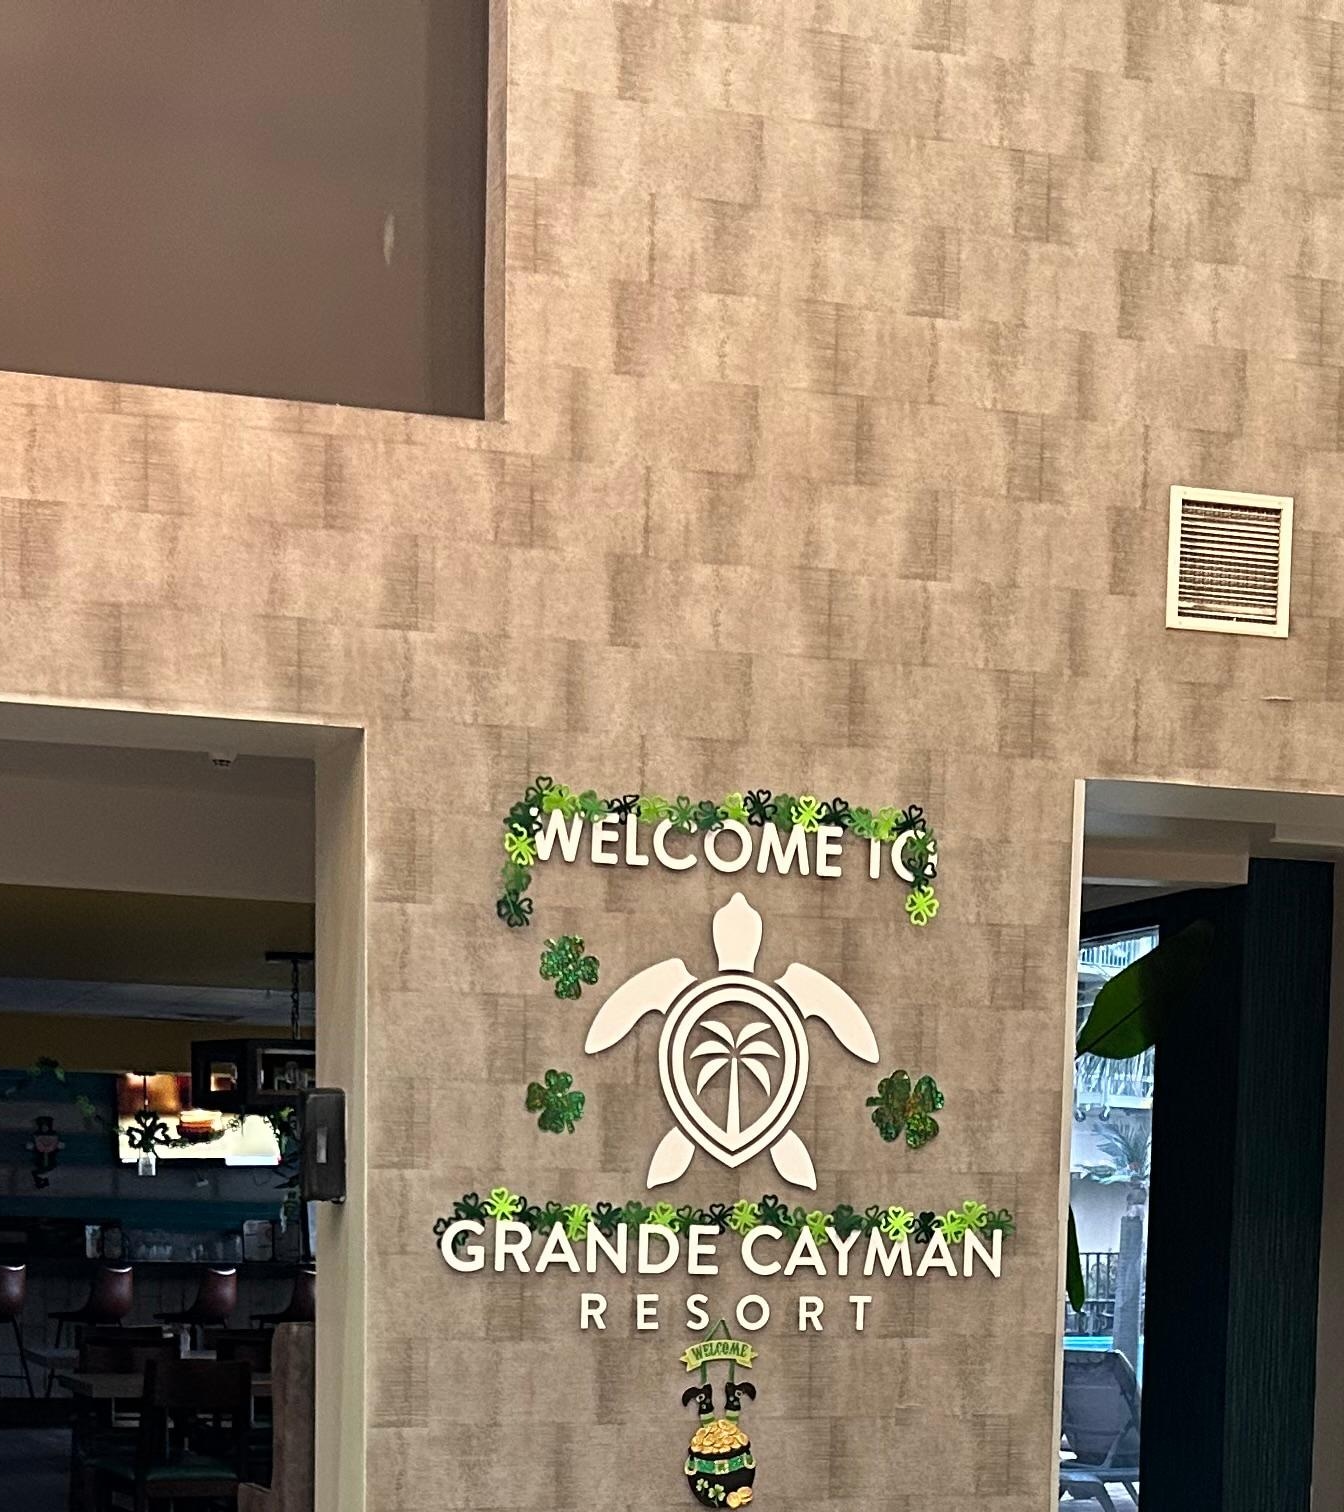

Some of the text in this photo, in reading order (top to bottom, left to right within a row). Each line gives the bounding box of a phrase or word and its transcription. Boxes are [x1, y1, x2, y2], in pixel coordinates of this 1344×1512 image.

[531, 806, 939, 883] WELCOME TO
[440, 1219, 1005, 1279] GRANDE CAYMAN
[579, 1293, 875, 1332] RESORT
[691, 1341, 749, 1361] WELCOME
